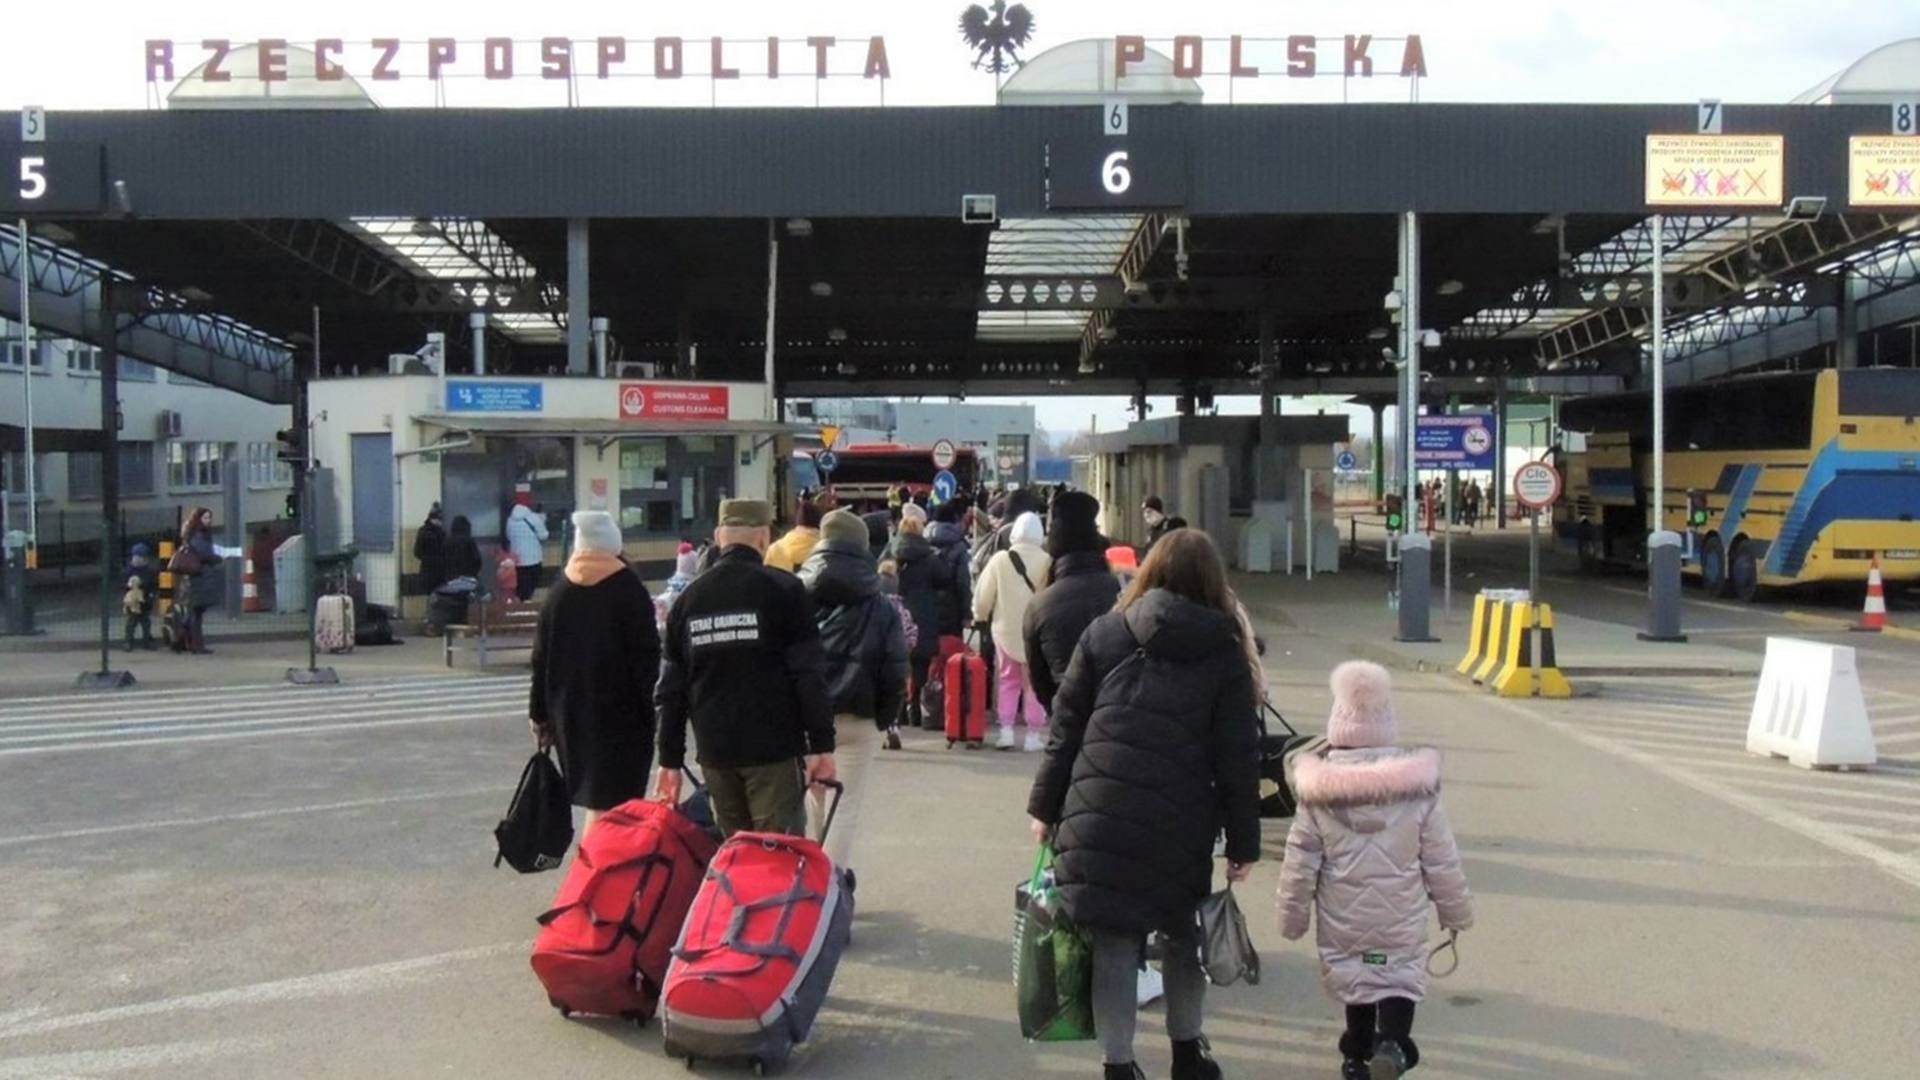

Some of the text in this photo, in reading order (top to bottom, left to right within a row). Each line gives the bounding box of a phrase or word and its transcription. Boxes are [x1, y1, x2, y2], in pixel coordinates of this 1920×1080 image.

[145, 34, 1427, 82] RZECZPOSPOLITA POLSKA
[28, 110, 38, 135] 5
[1111, 104, 1122, 129] 6
[1703, 103, 1719, 130] 7
[1897, 103, 1911, 132] 8
[20, 157, 46, 199] 5
[1102, 151, 1131, 193] 6
